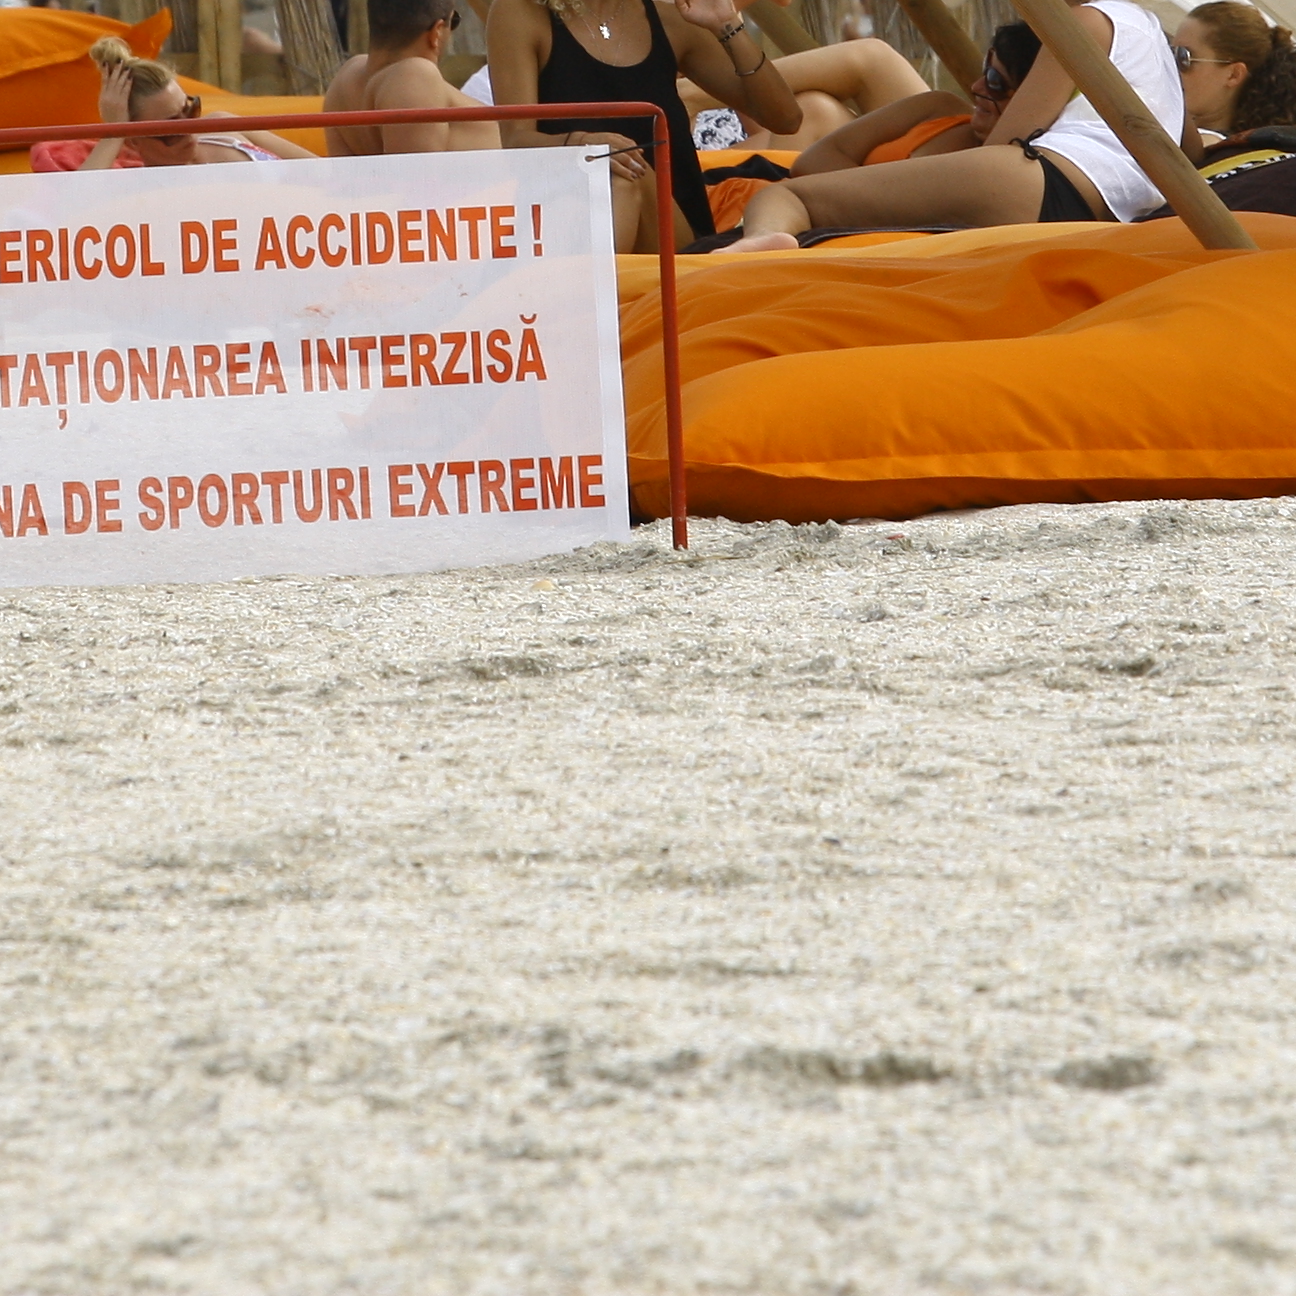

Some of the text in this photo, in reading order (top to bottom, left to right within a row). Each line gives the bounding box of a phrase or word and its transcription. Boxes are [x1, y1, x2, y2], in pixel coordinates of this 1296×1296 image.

[181, 219, 240, 274] DE
[256, 205, 517, 270] ACCIDENTE
[302, 313, 547, 393] INTERZISĂ
[64, 478, 123, 534] DE
[138, 466, 369, 530] SPORTURI
[389, 454, 606, 518] EXTREME
